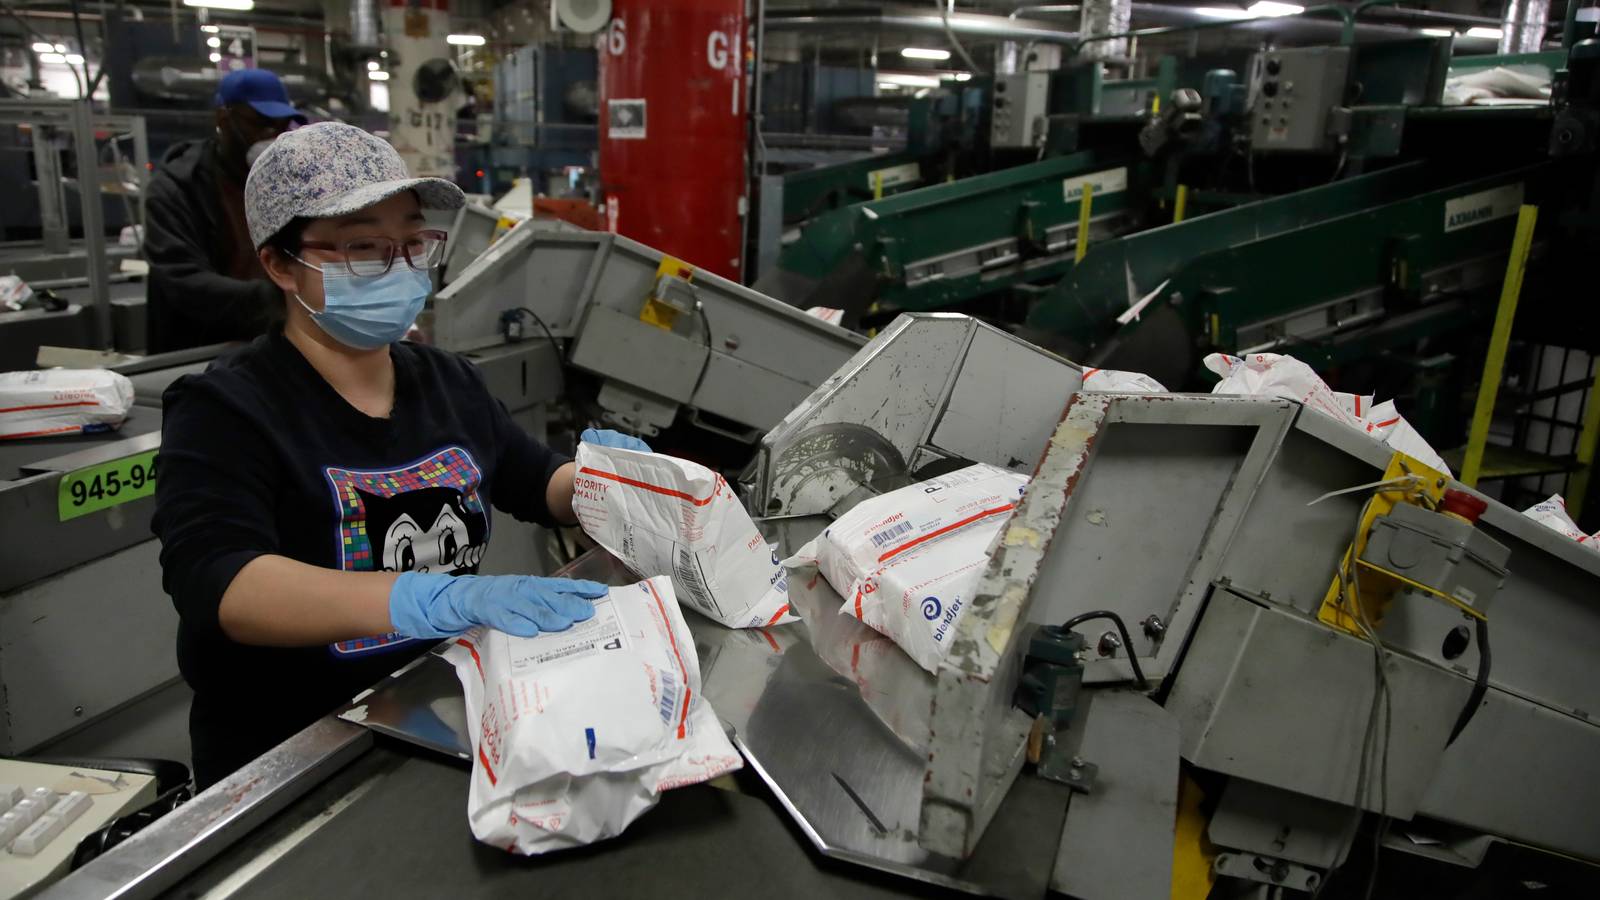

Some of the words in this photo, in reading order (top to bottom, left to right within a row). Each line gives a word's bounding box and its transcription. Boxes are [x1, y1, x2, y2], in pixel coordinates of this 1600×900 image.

[924, 486, 943, 496] P
[933, 596, 964, 642] blendjet
[603, 638, 622, 650] P
